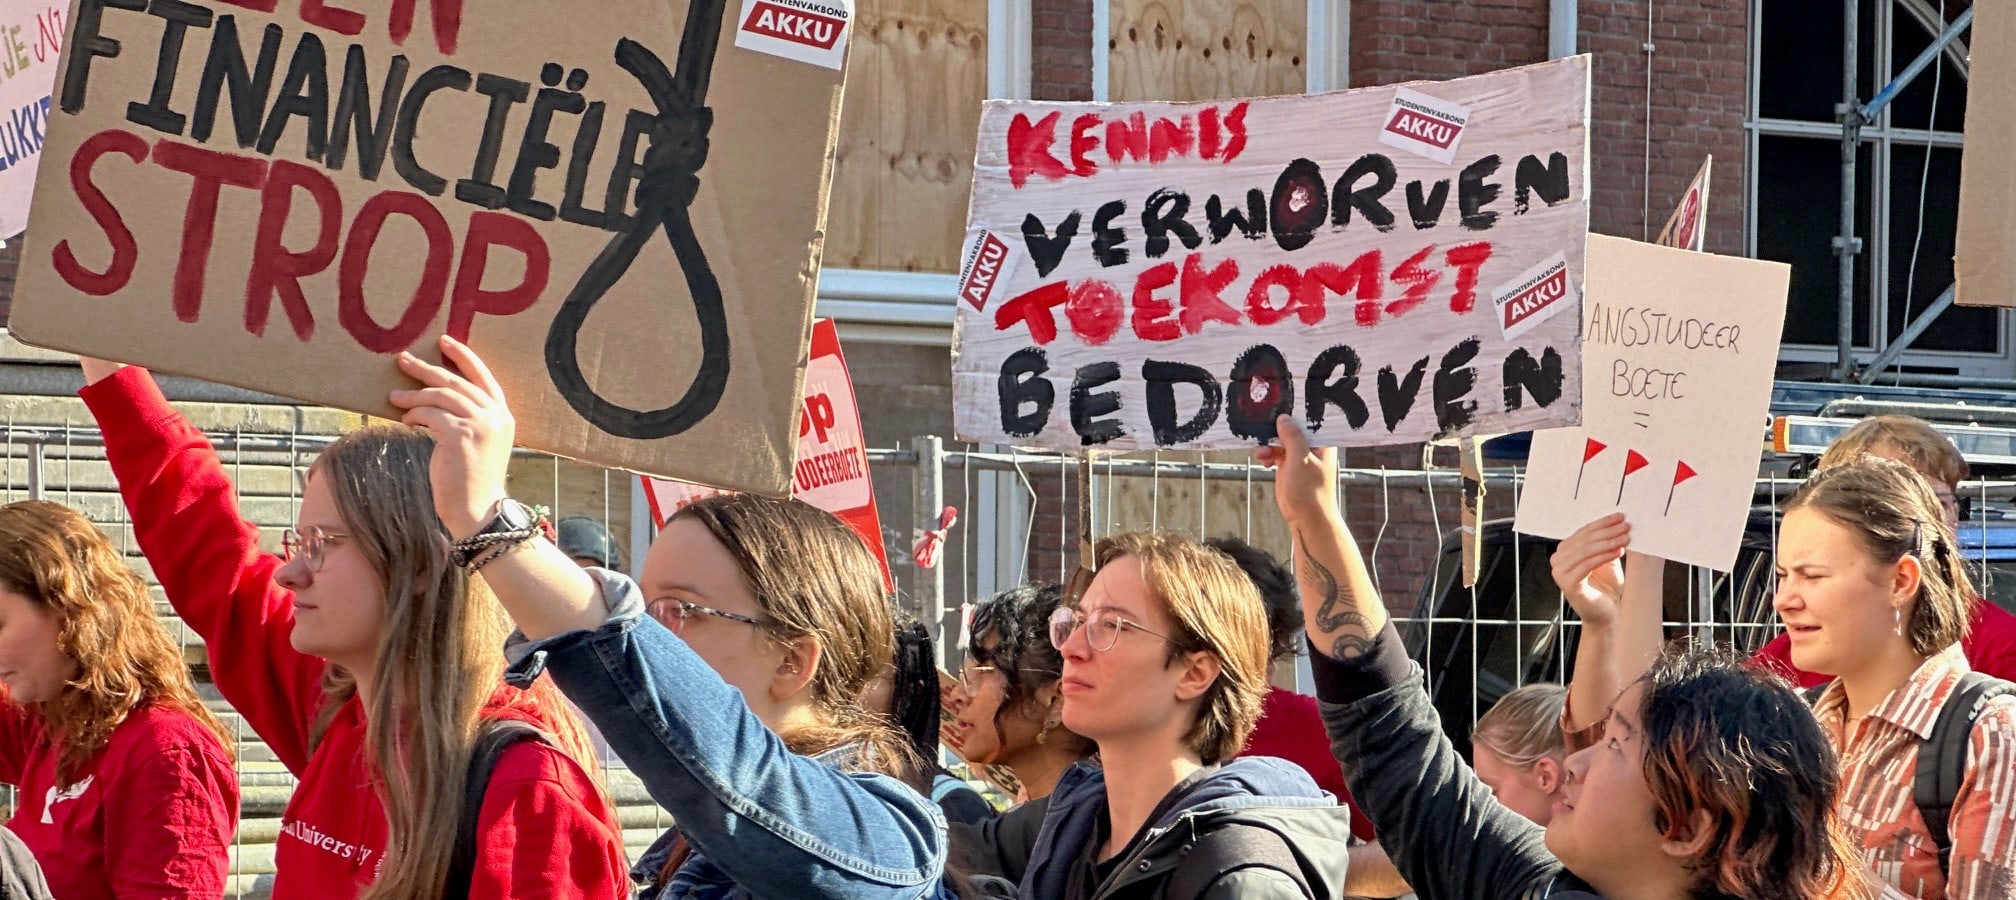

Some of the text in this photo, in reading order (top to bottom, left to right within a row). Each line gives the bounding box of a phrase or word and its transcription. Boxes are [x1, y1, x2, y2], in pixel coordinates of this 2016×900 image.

[755, 9, 833, 43] AKKU
[1394, 97, 1466, 125] STUDENTENVAKBOND
[1395, 114, 1452, 143] AKKU
[1007, 102, 1249, 189] KENNIS
[1020, 151, 1571, 278] VERWORVEN
[52, 129, 551, 373] STROP
[968, 242, 1003, 302] AKKU
[994, 241, 1493, 346] TOEKOMST
[1495, 260, 1566, 306] STUDENTENVAKBOND
[1511, 277, 1562, 320] AKKU
[1582, 302, 1741, 354] ANGSTUDEER
[997, 334, 1567, 446] BEDORVEN
[1612, 358, 1687, 400] BOETE
[792, 446, 863, 494] UDEERBOETE
